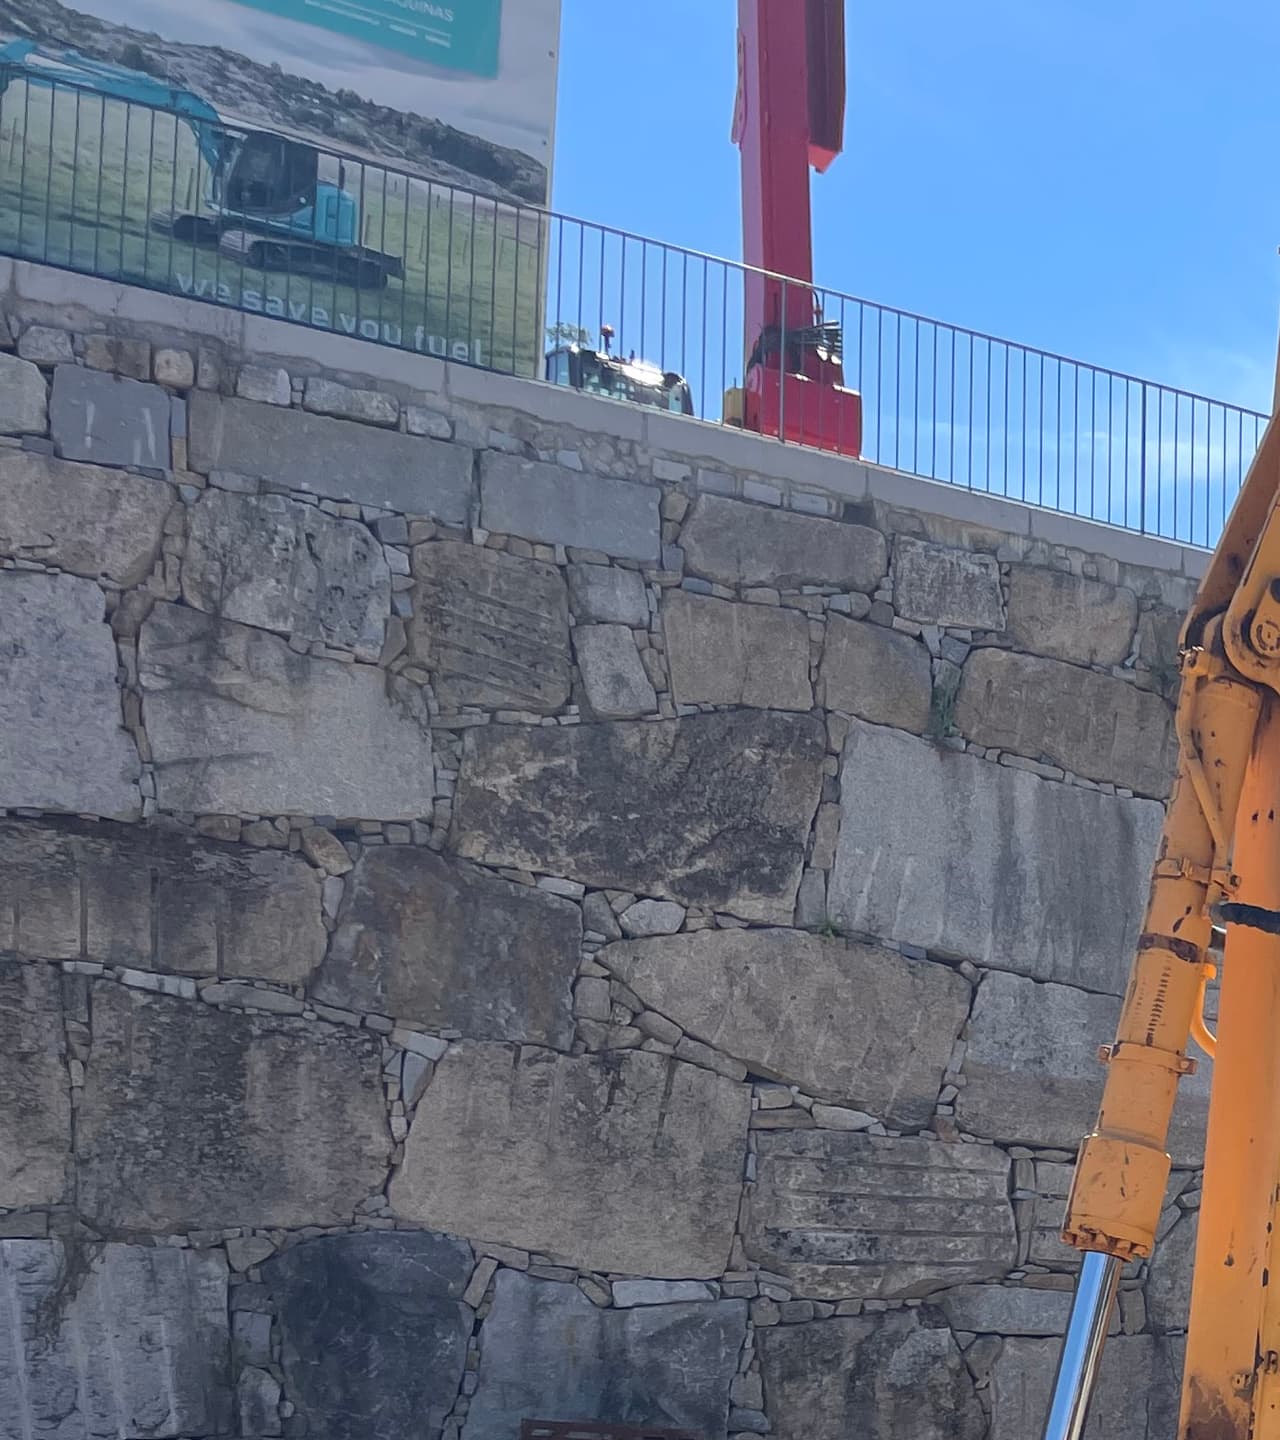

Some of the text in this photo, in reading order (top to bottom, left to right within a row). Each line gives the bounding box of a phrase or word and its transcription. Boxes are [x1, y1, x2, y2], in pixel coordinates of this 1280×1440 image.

[175, 272, 484, 366] we save you fuel
